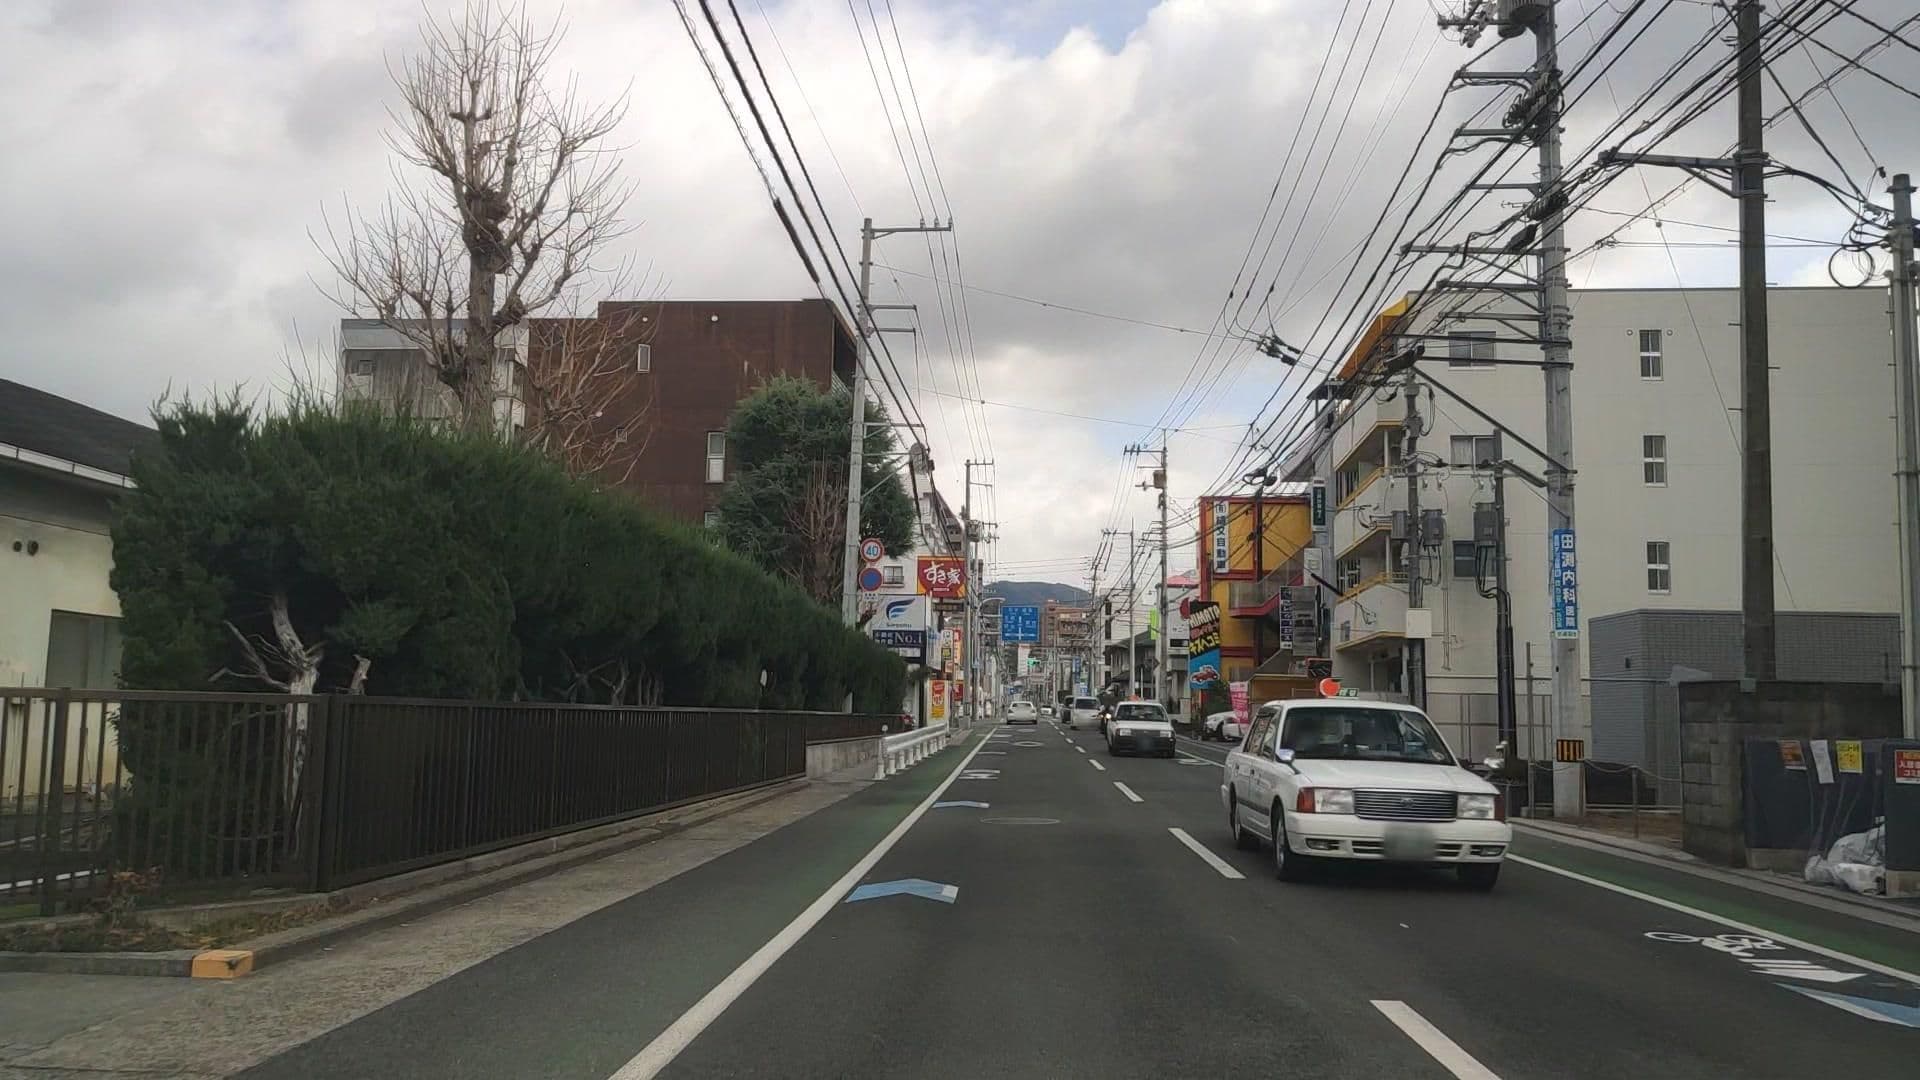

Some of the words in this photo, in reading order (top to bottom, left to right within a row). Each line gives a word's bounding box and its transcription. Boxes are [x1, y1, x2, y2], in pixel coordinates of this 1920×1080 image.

[866, 545, 879, 557] 40
[924, 560, 961, 588] すき家
[895, 632, 922, 643] No.1
